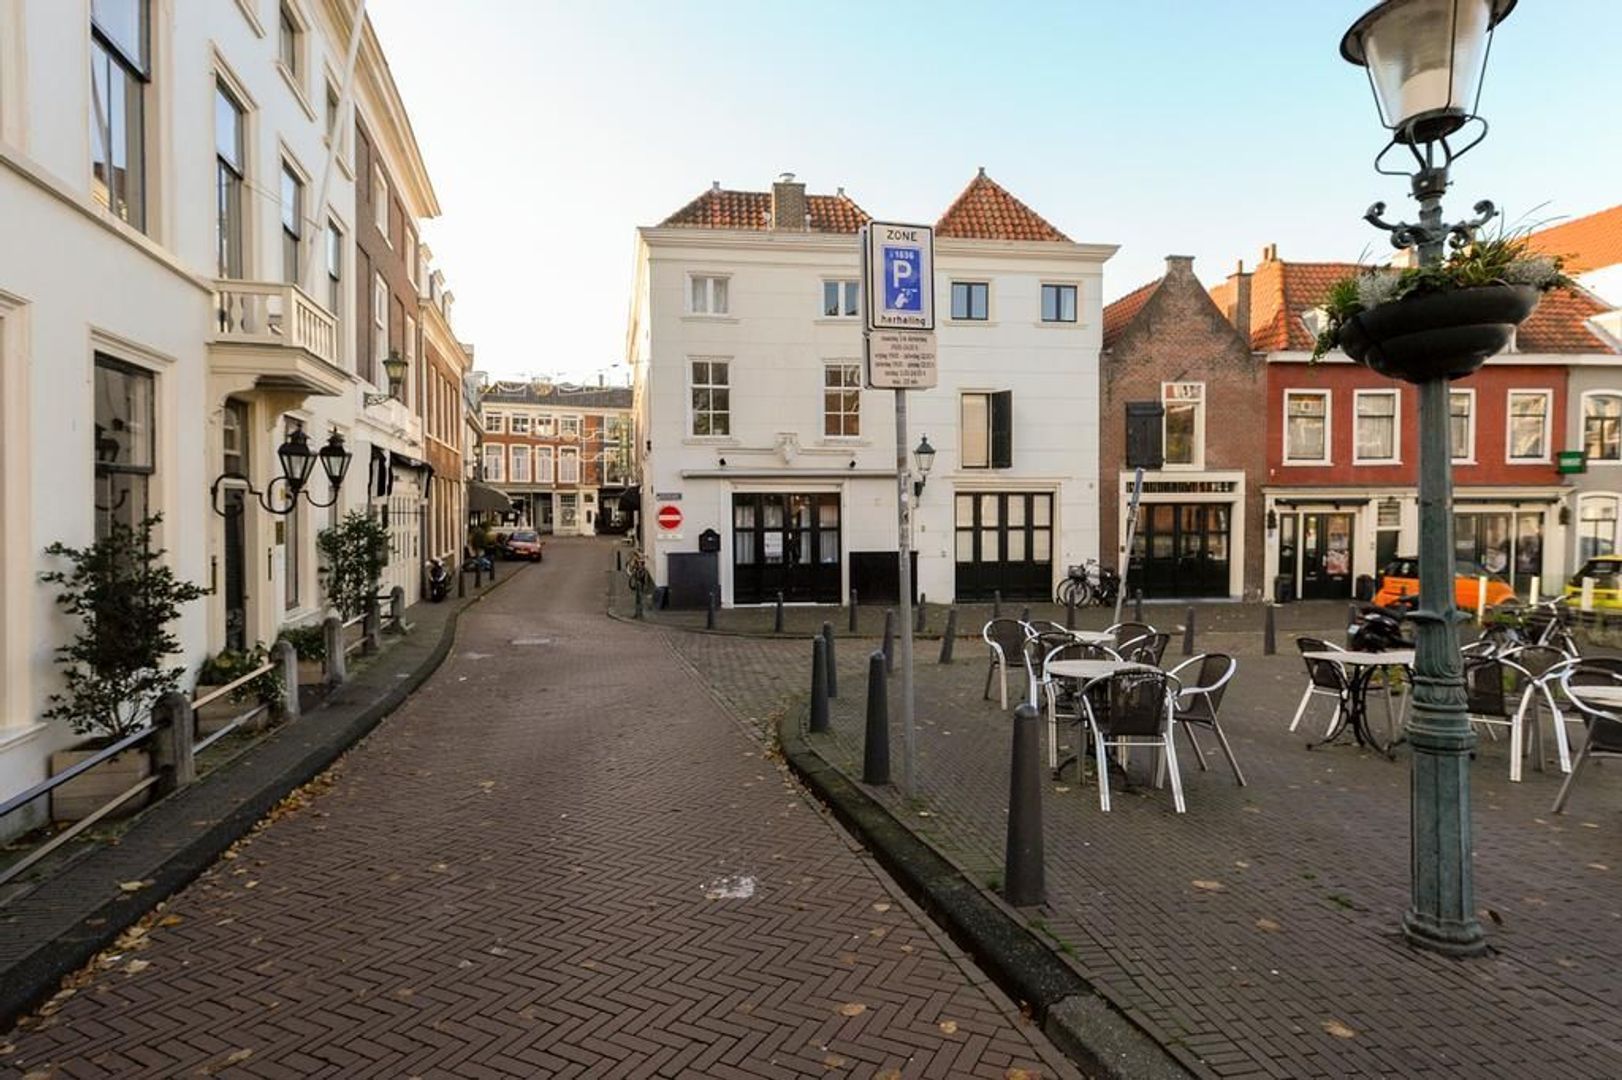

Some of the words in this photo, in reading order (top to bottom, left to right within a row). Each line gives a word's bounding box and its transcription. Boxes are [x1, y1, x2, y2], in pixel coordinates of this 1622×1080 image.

[887, 230, 917, 241] ZONE
[893, 260, 912, 289] P
[881, 315, 925, 326] herhaling
